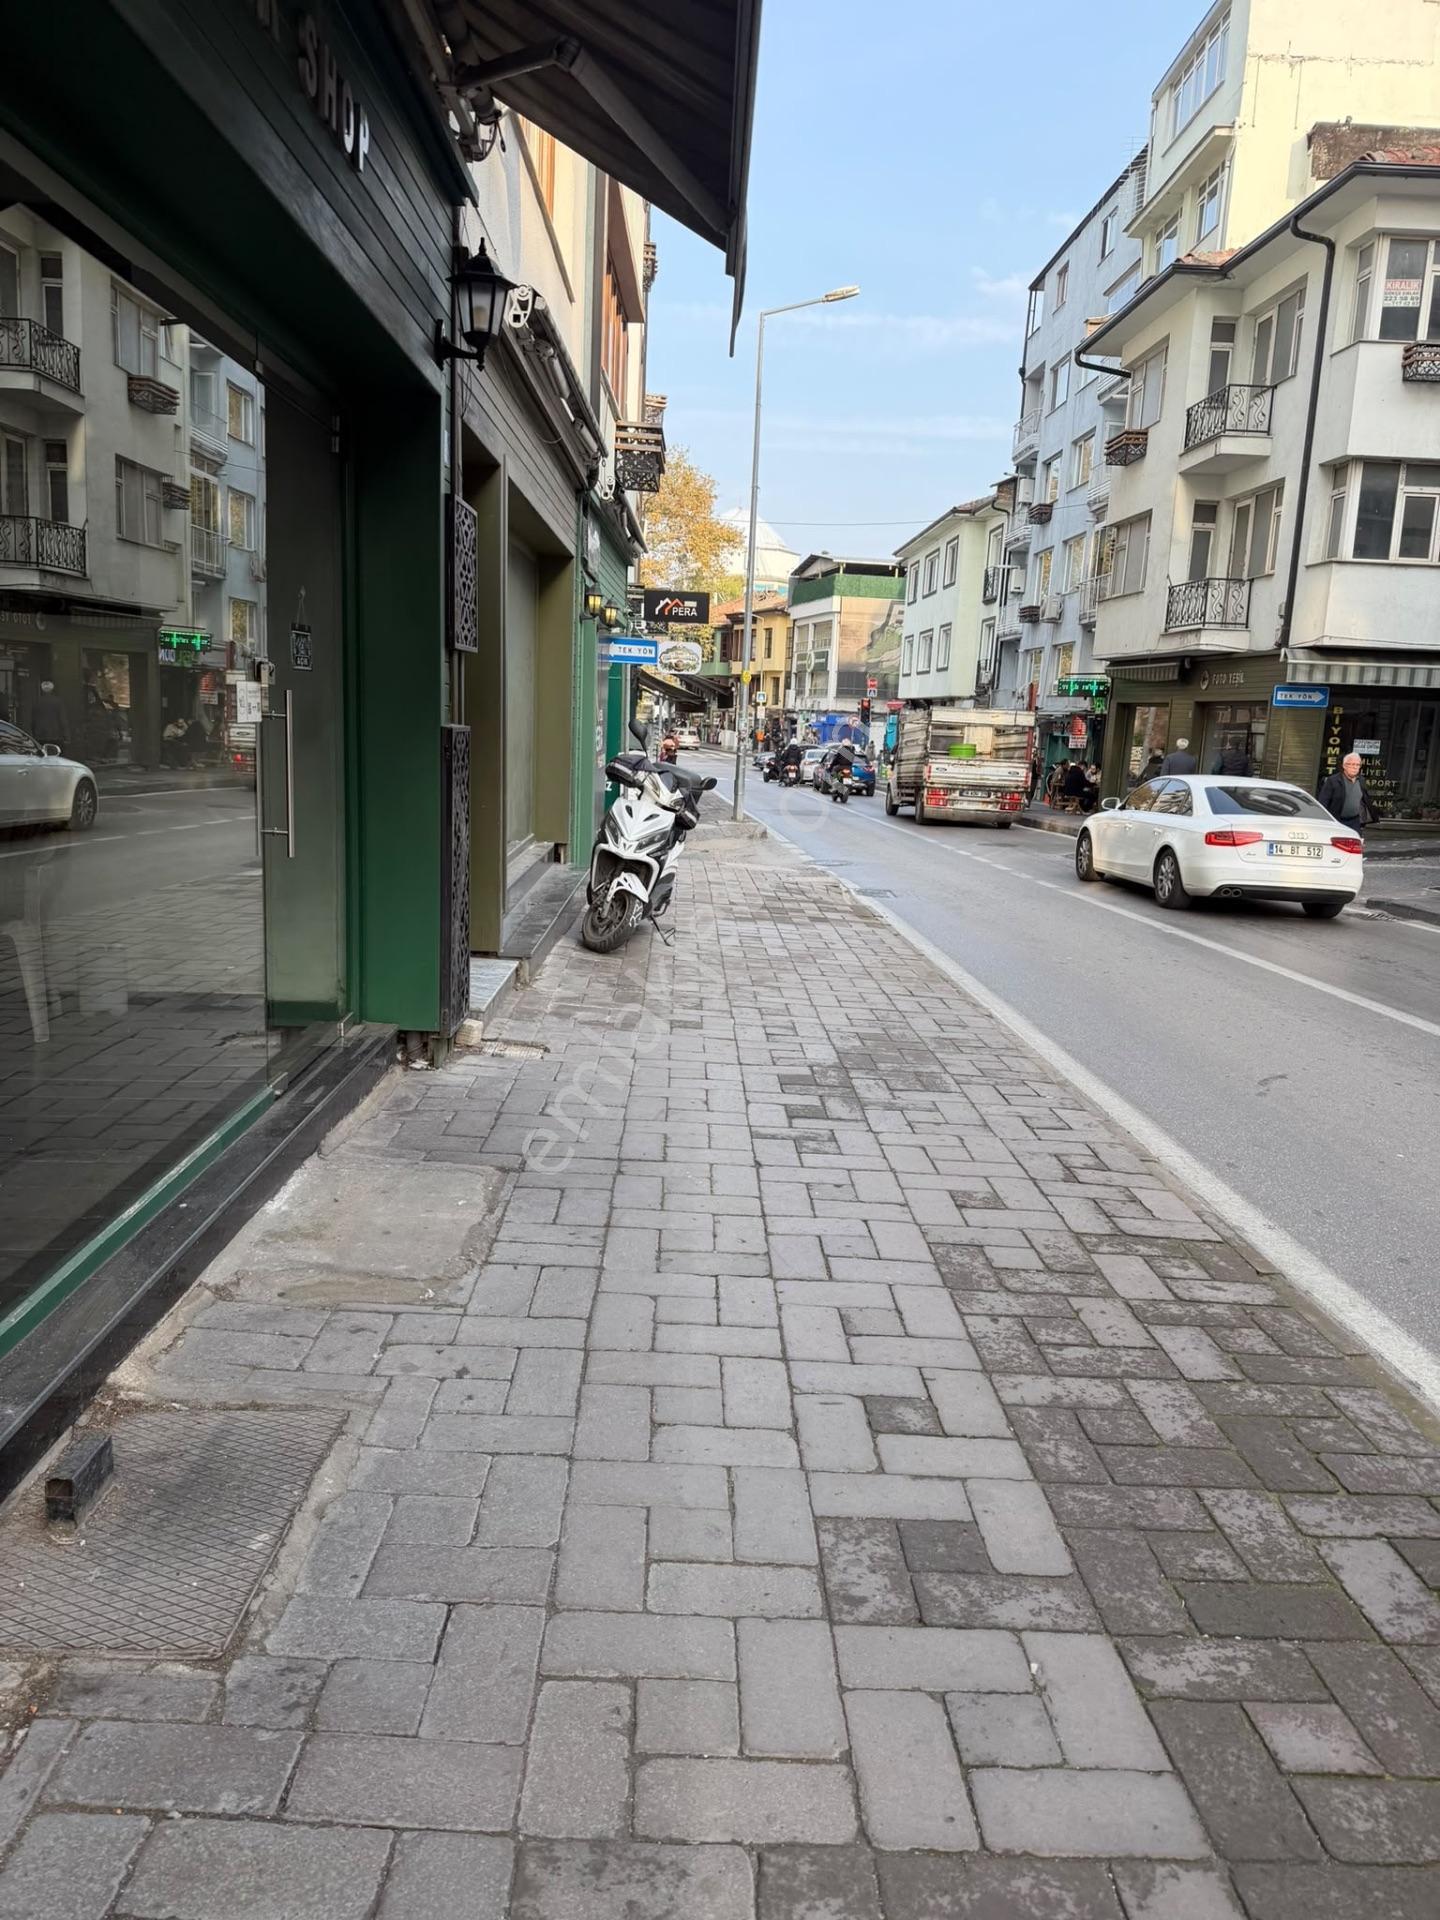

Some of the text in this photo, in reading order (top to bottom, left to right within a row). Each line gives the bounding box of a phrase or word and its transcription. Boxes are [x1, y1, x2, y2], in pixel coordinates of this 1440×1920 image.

[298, 14, 370, 174] SHOP
[672, 607, 698, 616] PERA
[618, 646, 653, 655] TEK YÖN
[1324, 706, 1343, 784] BİYOMET
[1275, 845, 1322, 857] 14 BT 512
